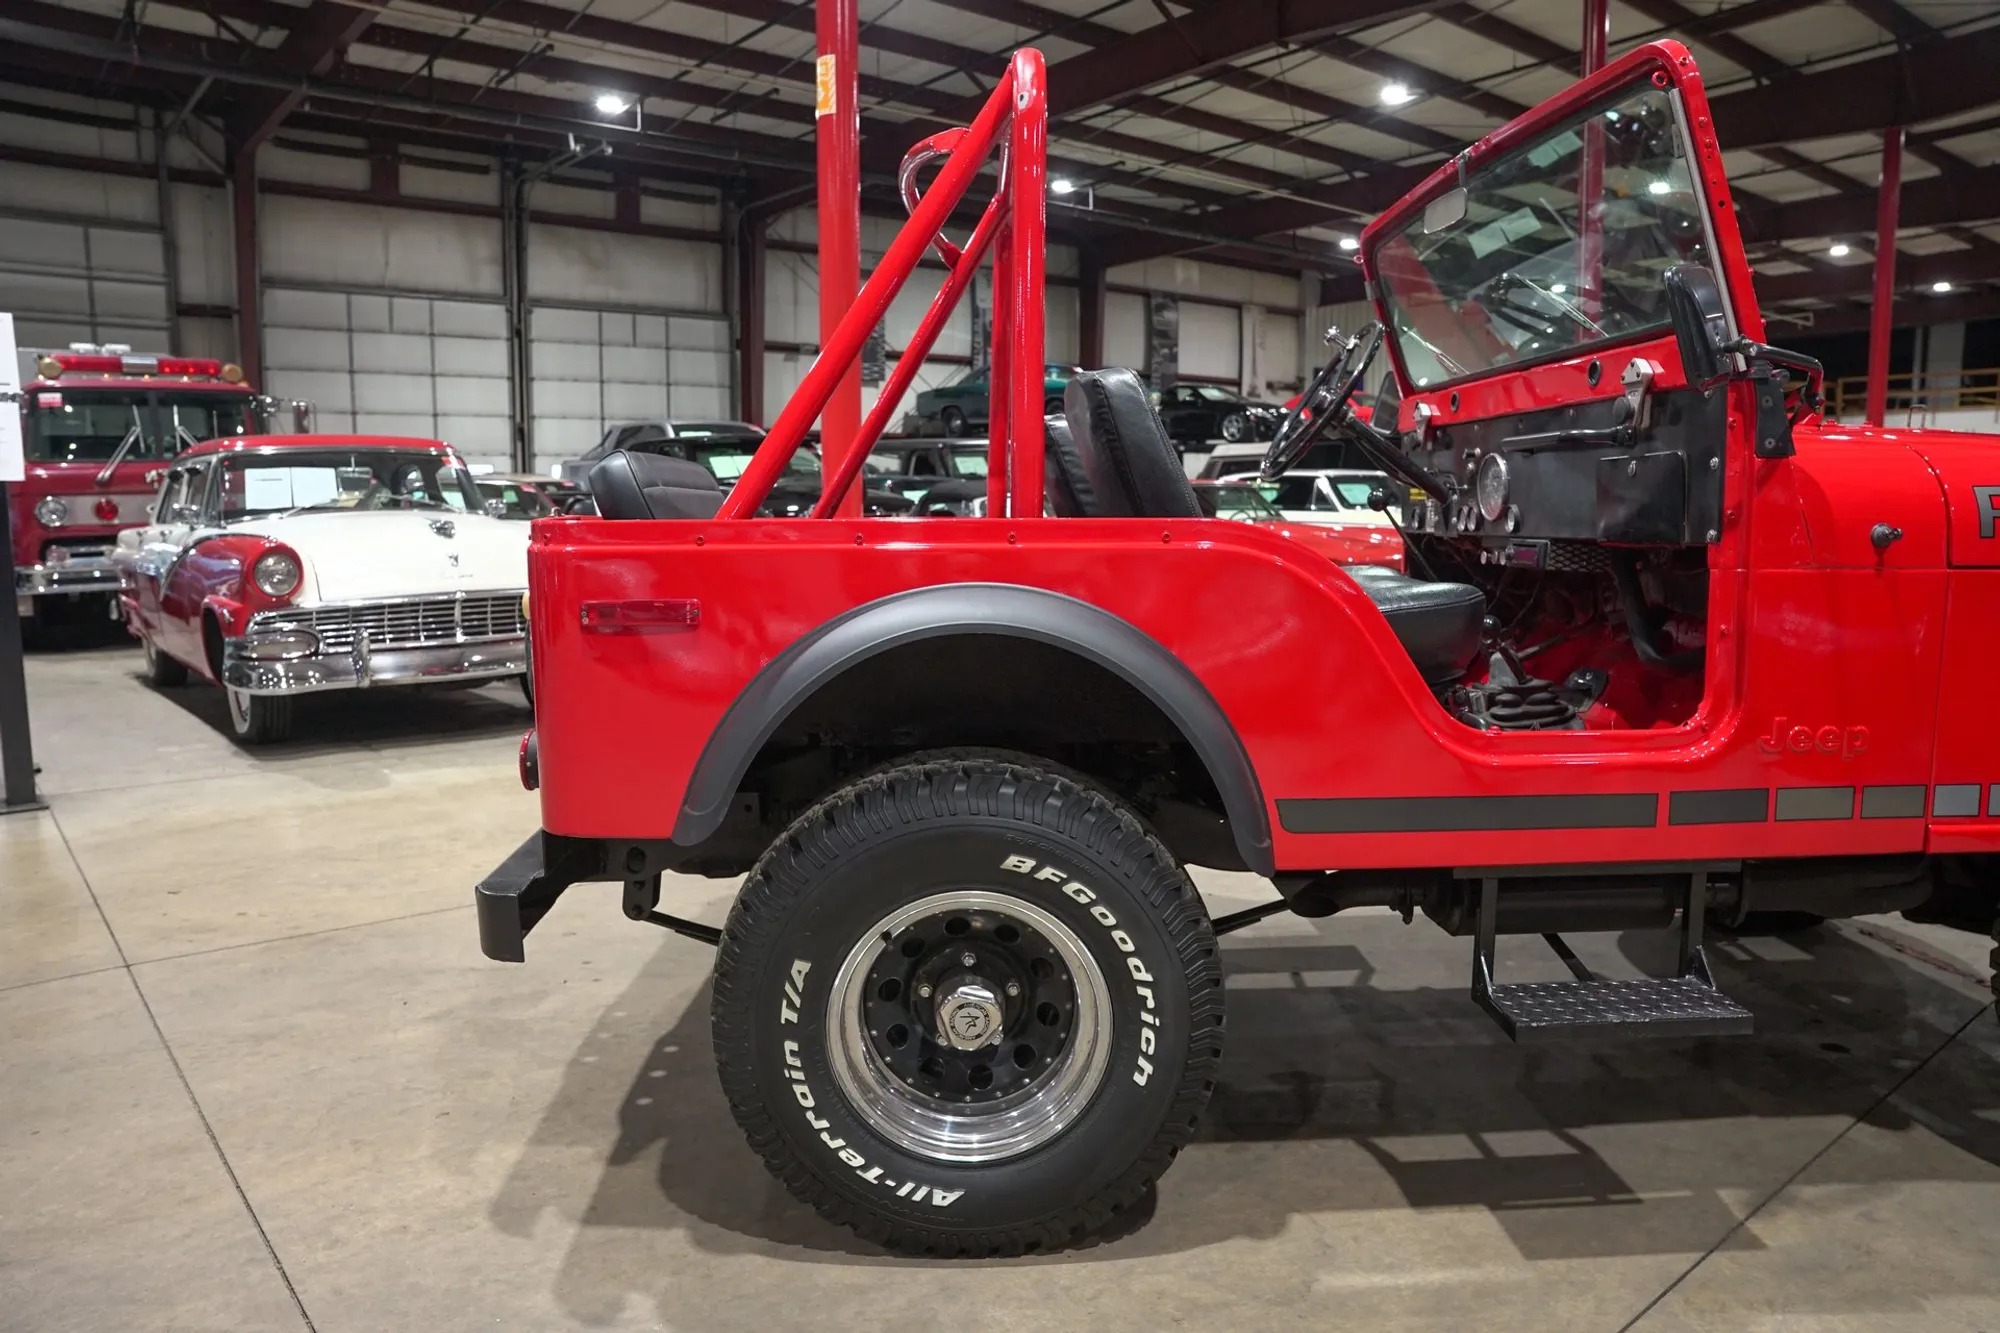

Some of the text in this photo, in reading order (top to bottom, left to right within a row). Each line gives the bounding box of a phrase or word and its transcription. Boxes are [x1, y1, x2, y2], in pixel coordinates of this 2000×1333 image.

[1760, 716, 1870, 761] Jeep
[780, 959, 812, 1025] T/A
[1000, 854, 1161, 1087] BFGoodrich
[783, 1040, 966, 1207] All-Terrain
